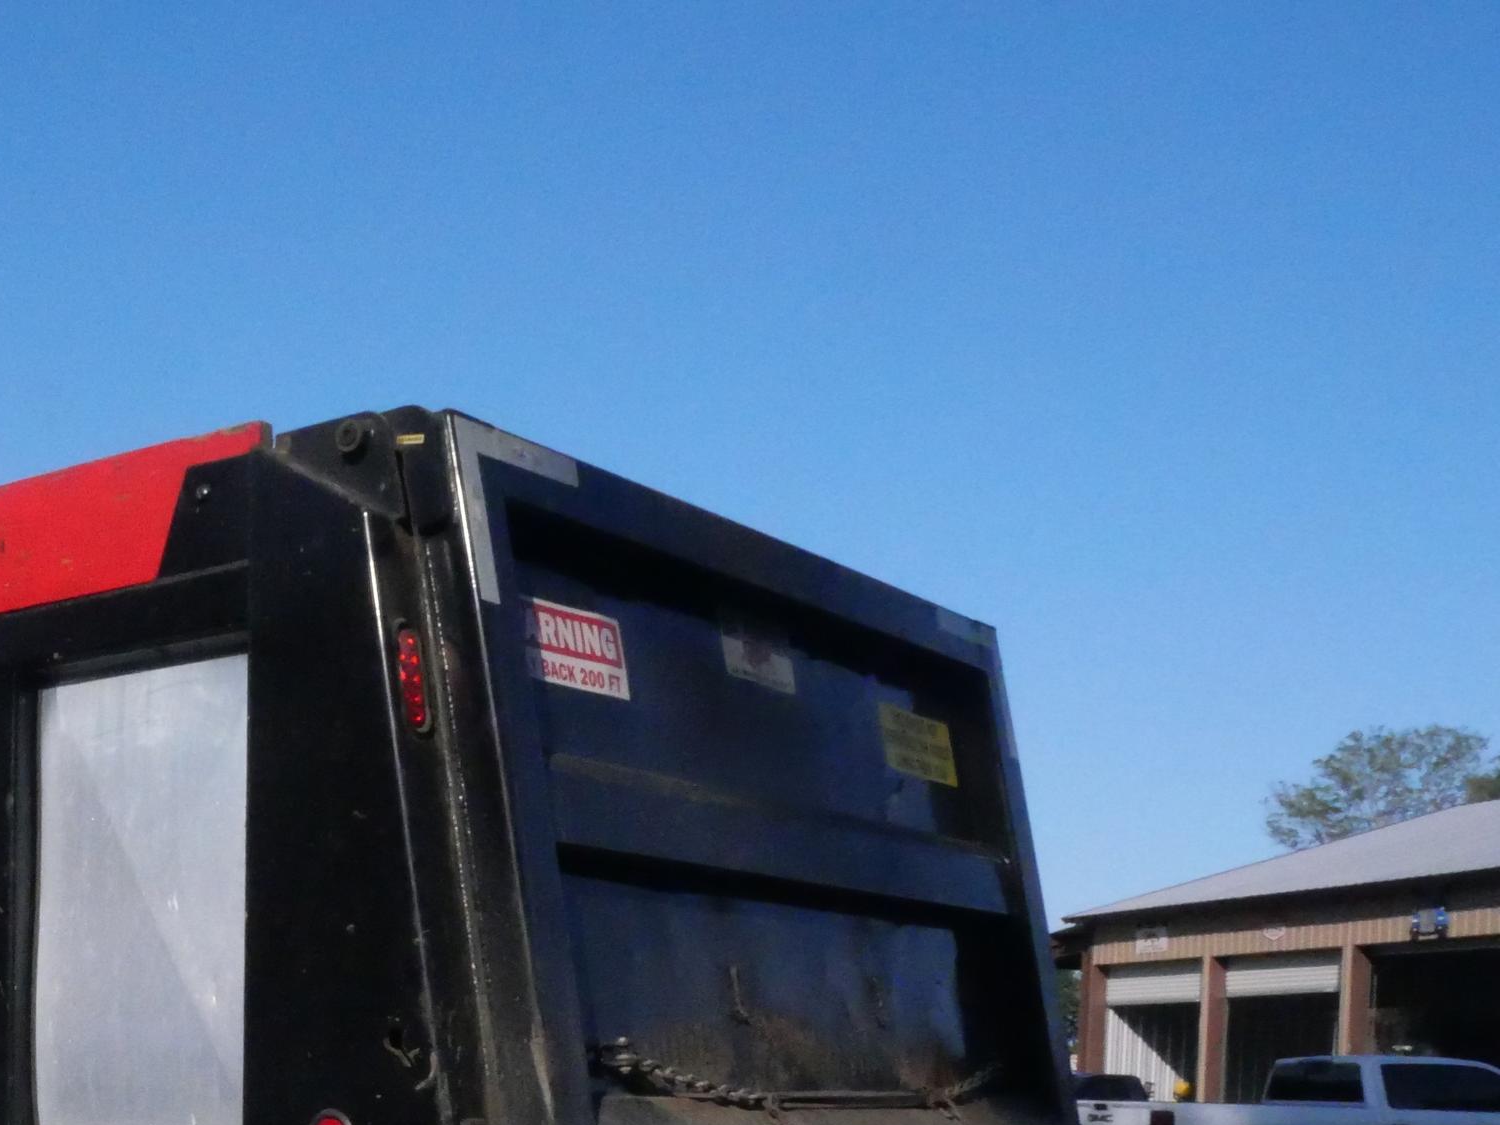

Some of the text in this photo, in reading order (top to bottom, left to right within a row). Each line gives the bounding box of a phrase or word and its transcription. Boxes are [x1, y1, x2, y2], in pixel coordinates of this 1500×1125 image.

[542, 659, 577, 683] BACK
[580, 667, 604, 689] 200
[609, 674, 621, 693] FT
